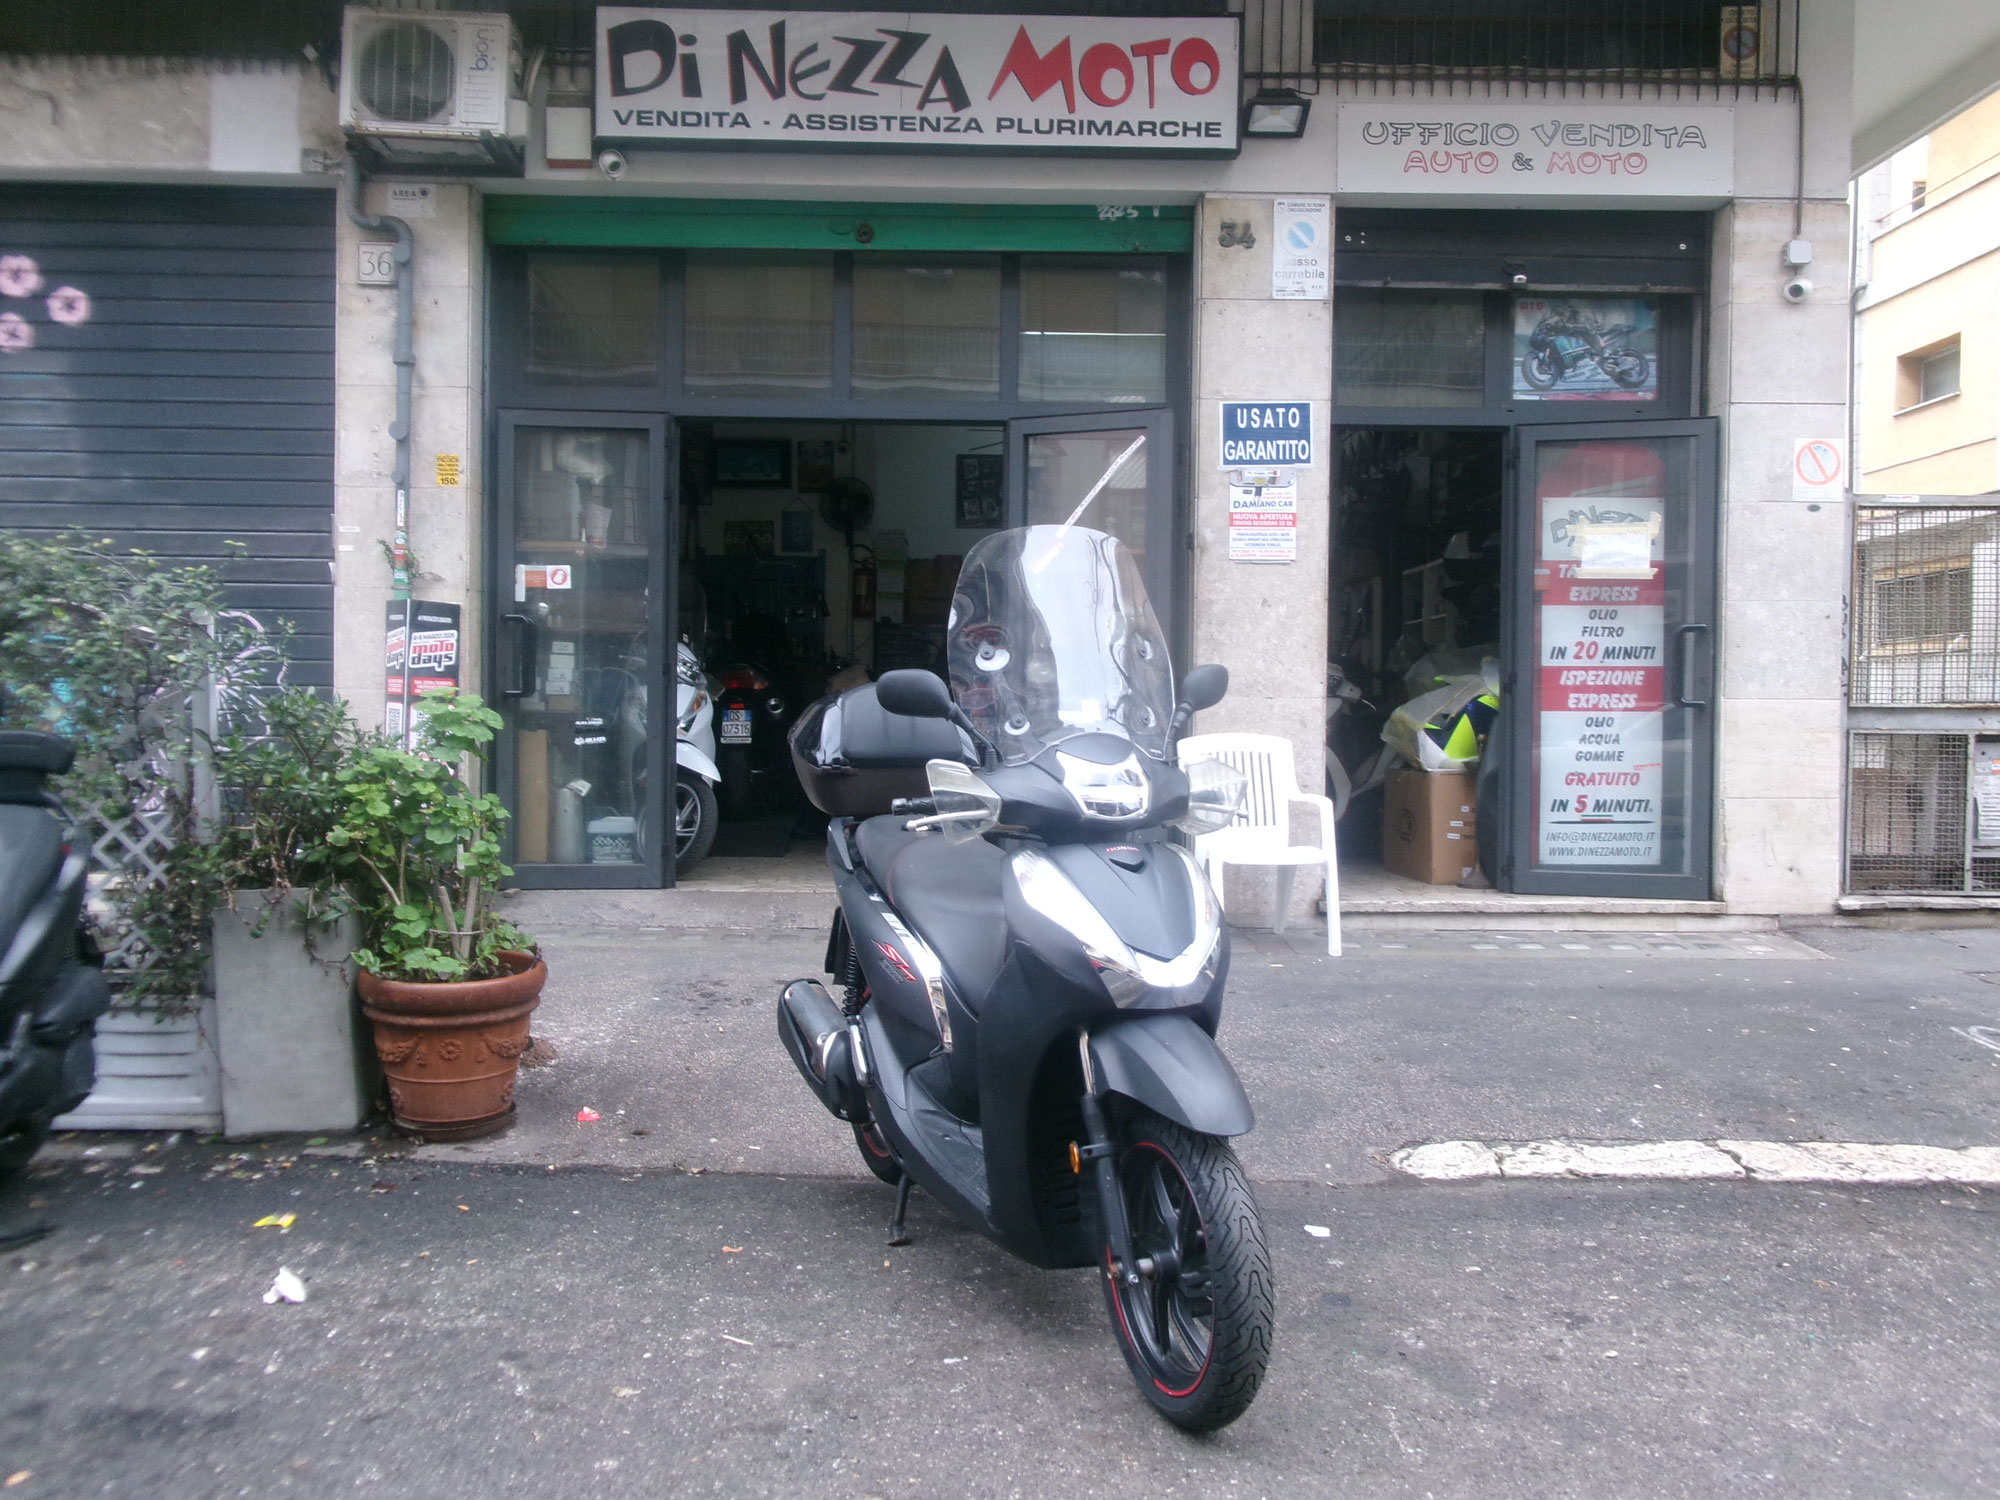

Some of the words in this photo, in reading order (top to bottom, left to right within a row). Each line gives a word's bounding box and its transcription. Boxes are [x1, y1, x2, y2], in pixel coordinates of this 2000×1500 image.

[987, 23, 1221, 114] MOTO
[612, 109, 752, 129] VENDITA
[782, 113, 984, 133] ASSISTENZA
[996, 116, 1222, 138] PLURIMARCHE
[1362, 121, 1519, 147] UFFICIO
[1531, 120, 1707, 149] VENDITA
[1403, 150, 1498, 174] AUTO
[1511, 152, 1534, 171] &
[1547, 151, 1647, 175] MOTO
[1218, 220, 1256, 249] 34
[361, 250, 392, 277] 36
[1274, 269, 1325, 279] carrabile
[1236, 407, 1300, 429] USATO
[1224, 439, 1310, 461] GARANTITO
[1232, 500, 1277, 509] DAMIANO
[1569, 586, 1640, 602] EXPRESS
[1588, 609, 1618, 620] OLIO
[1581, 626, 1625, 638] FILTRO
[412, 640, 455, 655] moto
[1550, 646, 1568, 660] IN
[1572, 641, 1599, 660] 20
[1602, 646, 1657, 661] MINUTI
[411, 652, 454, 668] days
[1559, 670, 1646, 686] ISPEZIONE
[1567, 693, 1639, 709] EXPRESS
[1585, 717, 1615, 728] OLIO
[1578, 733, 1621, 746] ACQUA
[1575, 750, 1625, 762] GOMME
[1564, 772, 1641, 787] GRATUITO
[1550, 799, 1570, 813] IN
[1574, 794, 1589, 813] 5
[1545, 831, 1656, 844] INFO@DINEZZAMOTO.IT
[1548, 846, 1654, 857] WWW.DINEZZAMOTO.IT
